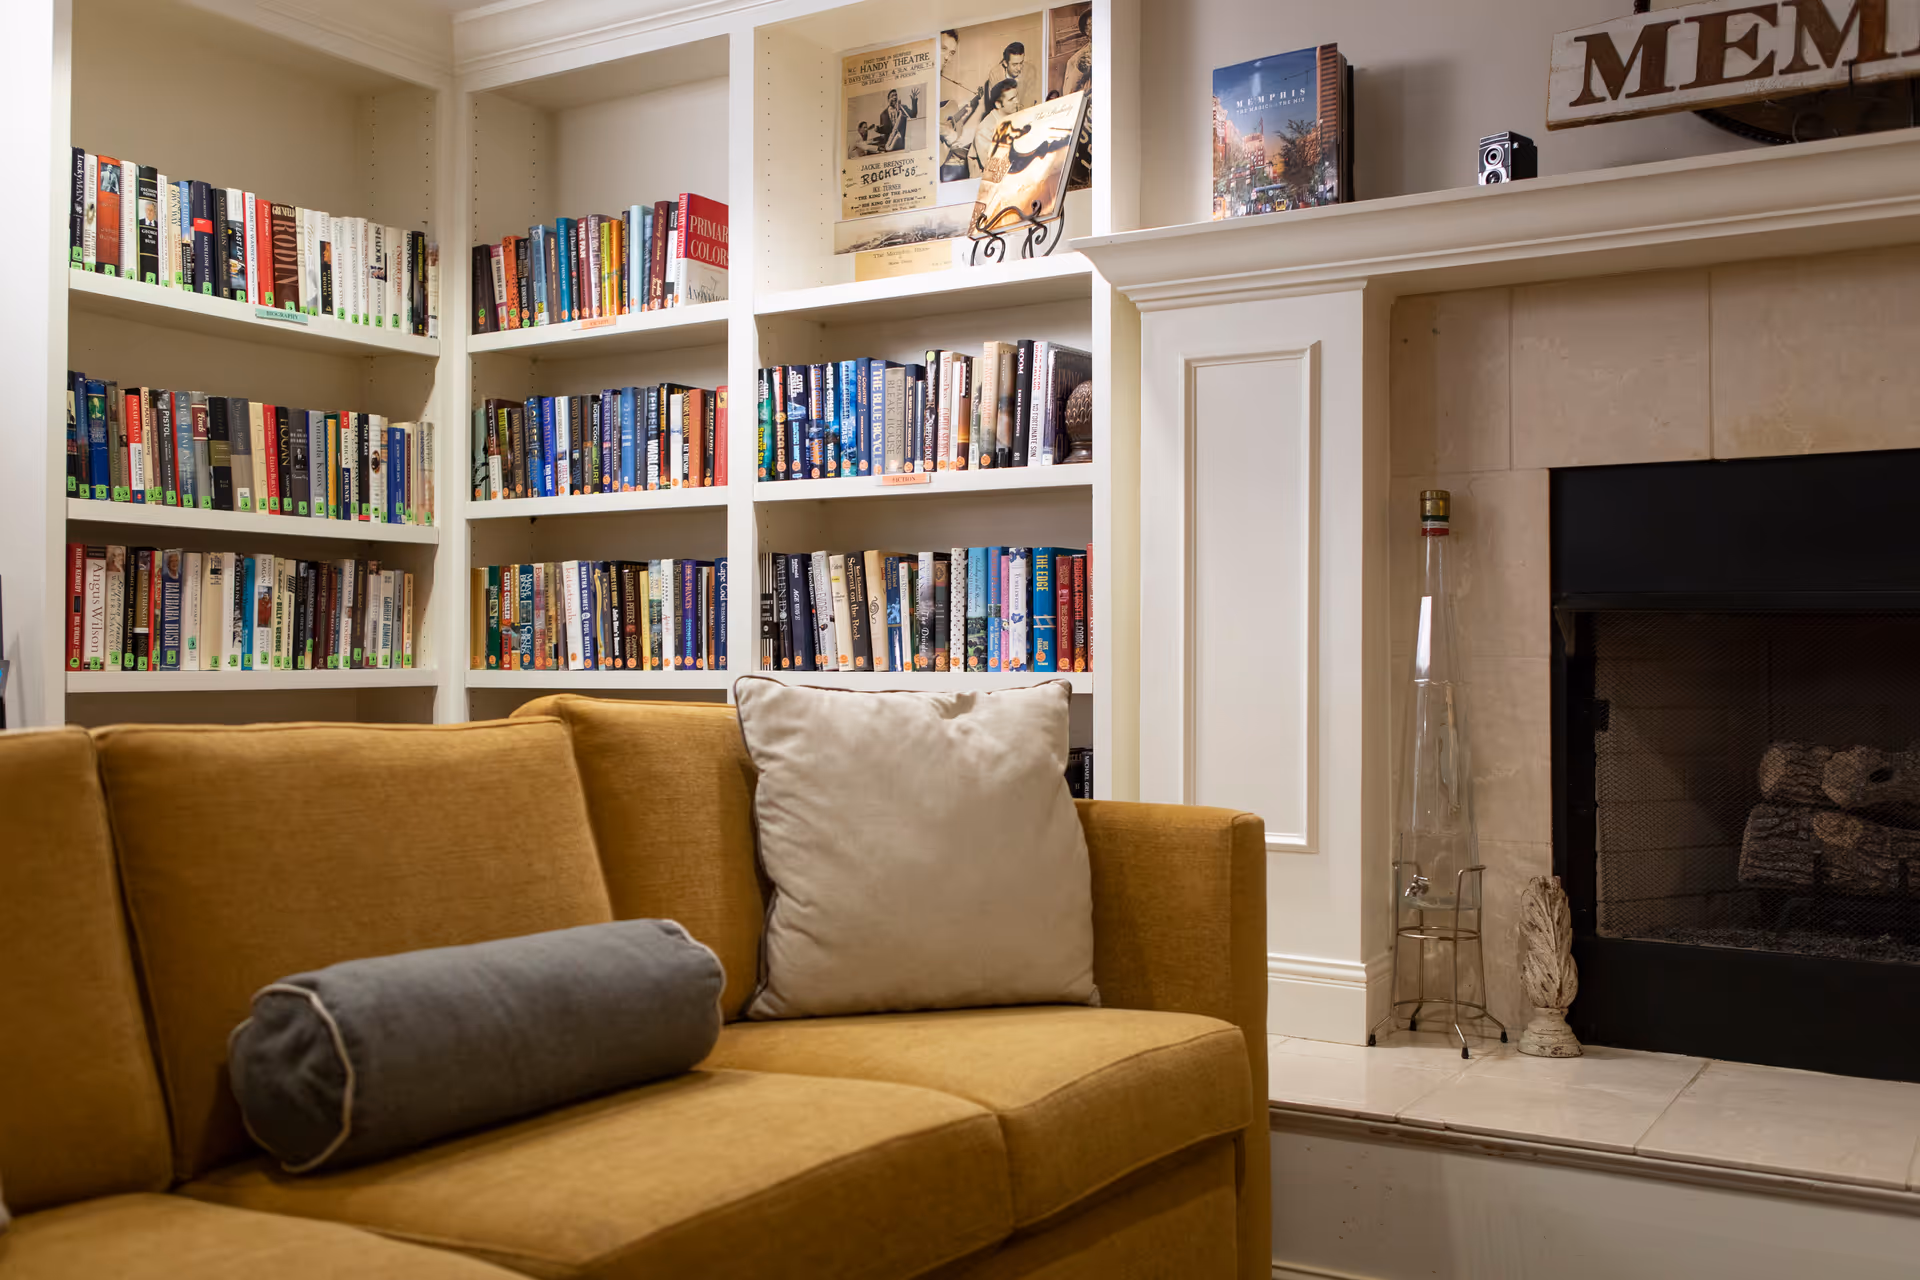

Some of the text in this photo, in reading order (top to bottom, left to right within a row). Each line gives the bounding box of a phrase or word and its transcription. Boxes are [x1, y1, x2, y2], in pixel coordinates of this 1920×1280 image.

[860, 52, 930, 73] HANDY THEATRE
[1569, 0, 1920, 107] MEM
[1236, 87, 1306, 108] MEMPHIS
[884, 158, 914, 168] BRENSTON
[678, 194, 688, 227] PRIMARY
[689, 214, 728, 244] PRIMAR
[272, 220, 298, 286] RODIN
[266, 310, 300, 320] BIOGRAPHY
[872, 369, 882, 420] THE BLUE
[1032, 404, 1038, 412] NO
[180, 396, 188, 428] SARAH
[648, 392, 658, 437] TED BELL
[280, 418, 290, 466] HOGAN
[316, 417, 324, 488] Amanda Knox
[718, 561, 728, 601] Cape Cod
[846, 557, 856, 590] Serpent
[1036, 554, 1048, 592] THE EDGE
[1074, 558, 1084, 592] FREDERICK
[88, 562, 104, 652] Angus Wilson
[626, 572, 634, 624] ELIZABETH PETERS
[850, 592, 856, 602] on
[1075, 592, 1084, 620] FORSYTH
[164, 582, 180, 646] BARBARA BUSH
[852, 619, 860, 640] Rock
[382, 623, 392, 650] ADMIRAL
